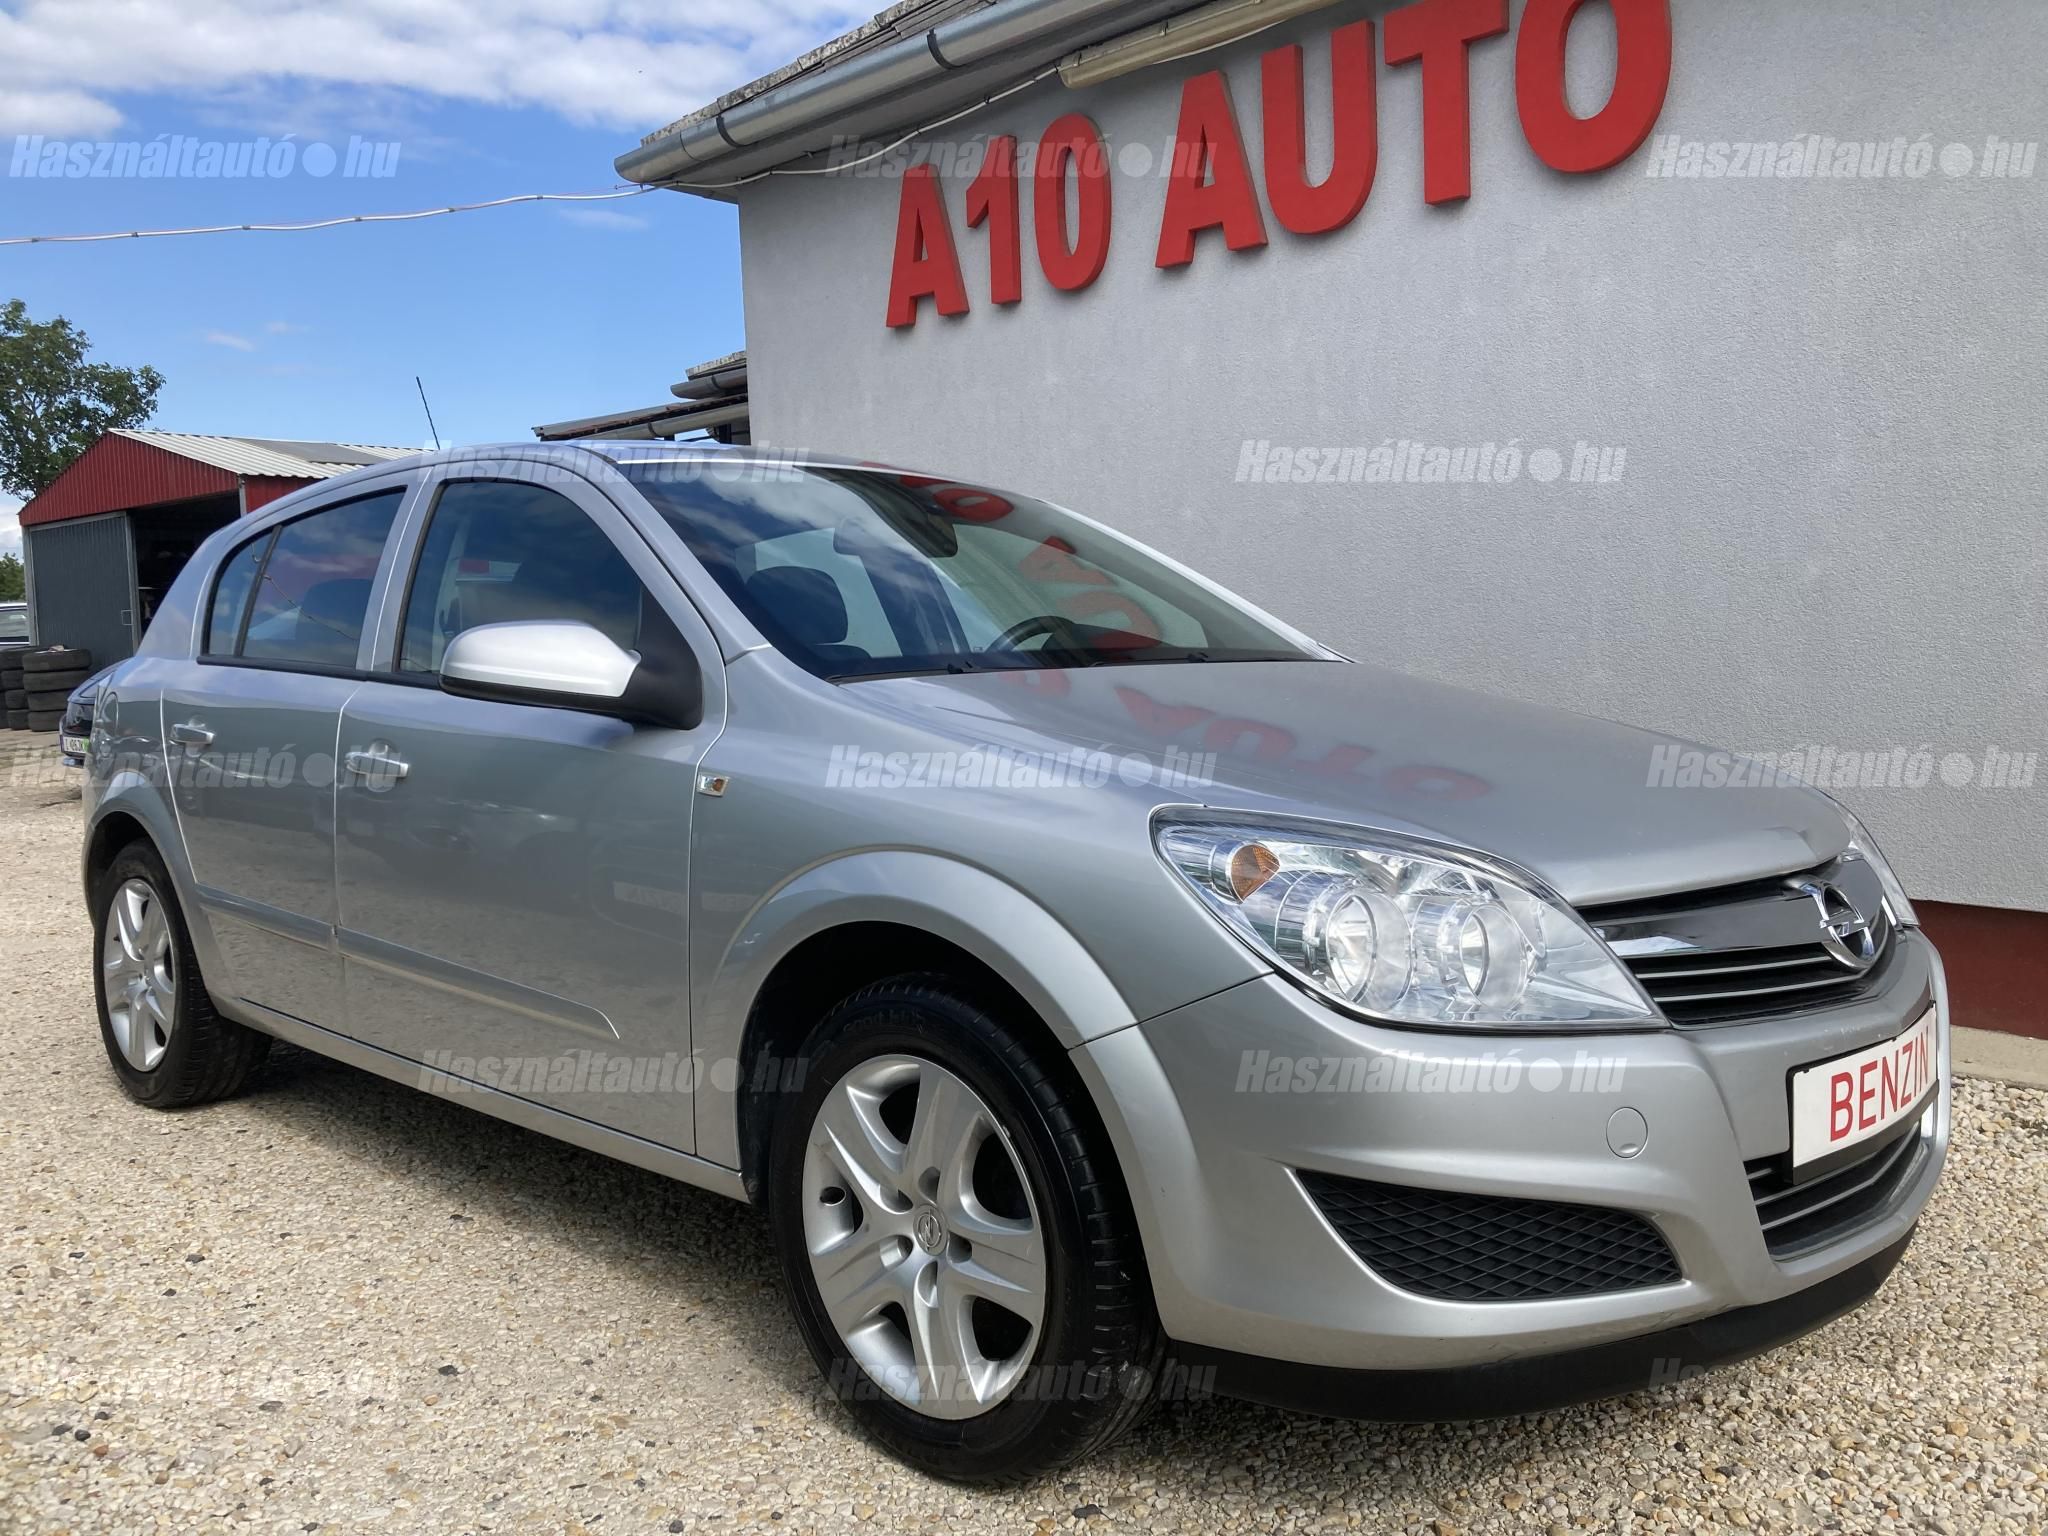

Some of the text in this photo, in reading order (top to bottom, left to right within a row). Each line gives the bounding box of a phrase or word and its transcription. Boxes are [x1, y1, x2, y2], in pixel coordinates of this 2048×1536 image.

[886, 0, 1673, 328] A10 AUTO
[1830, 1025, 1929, 1142] BENZIN
